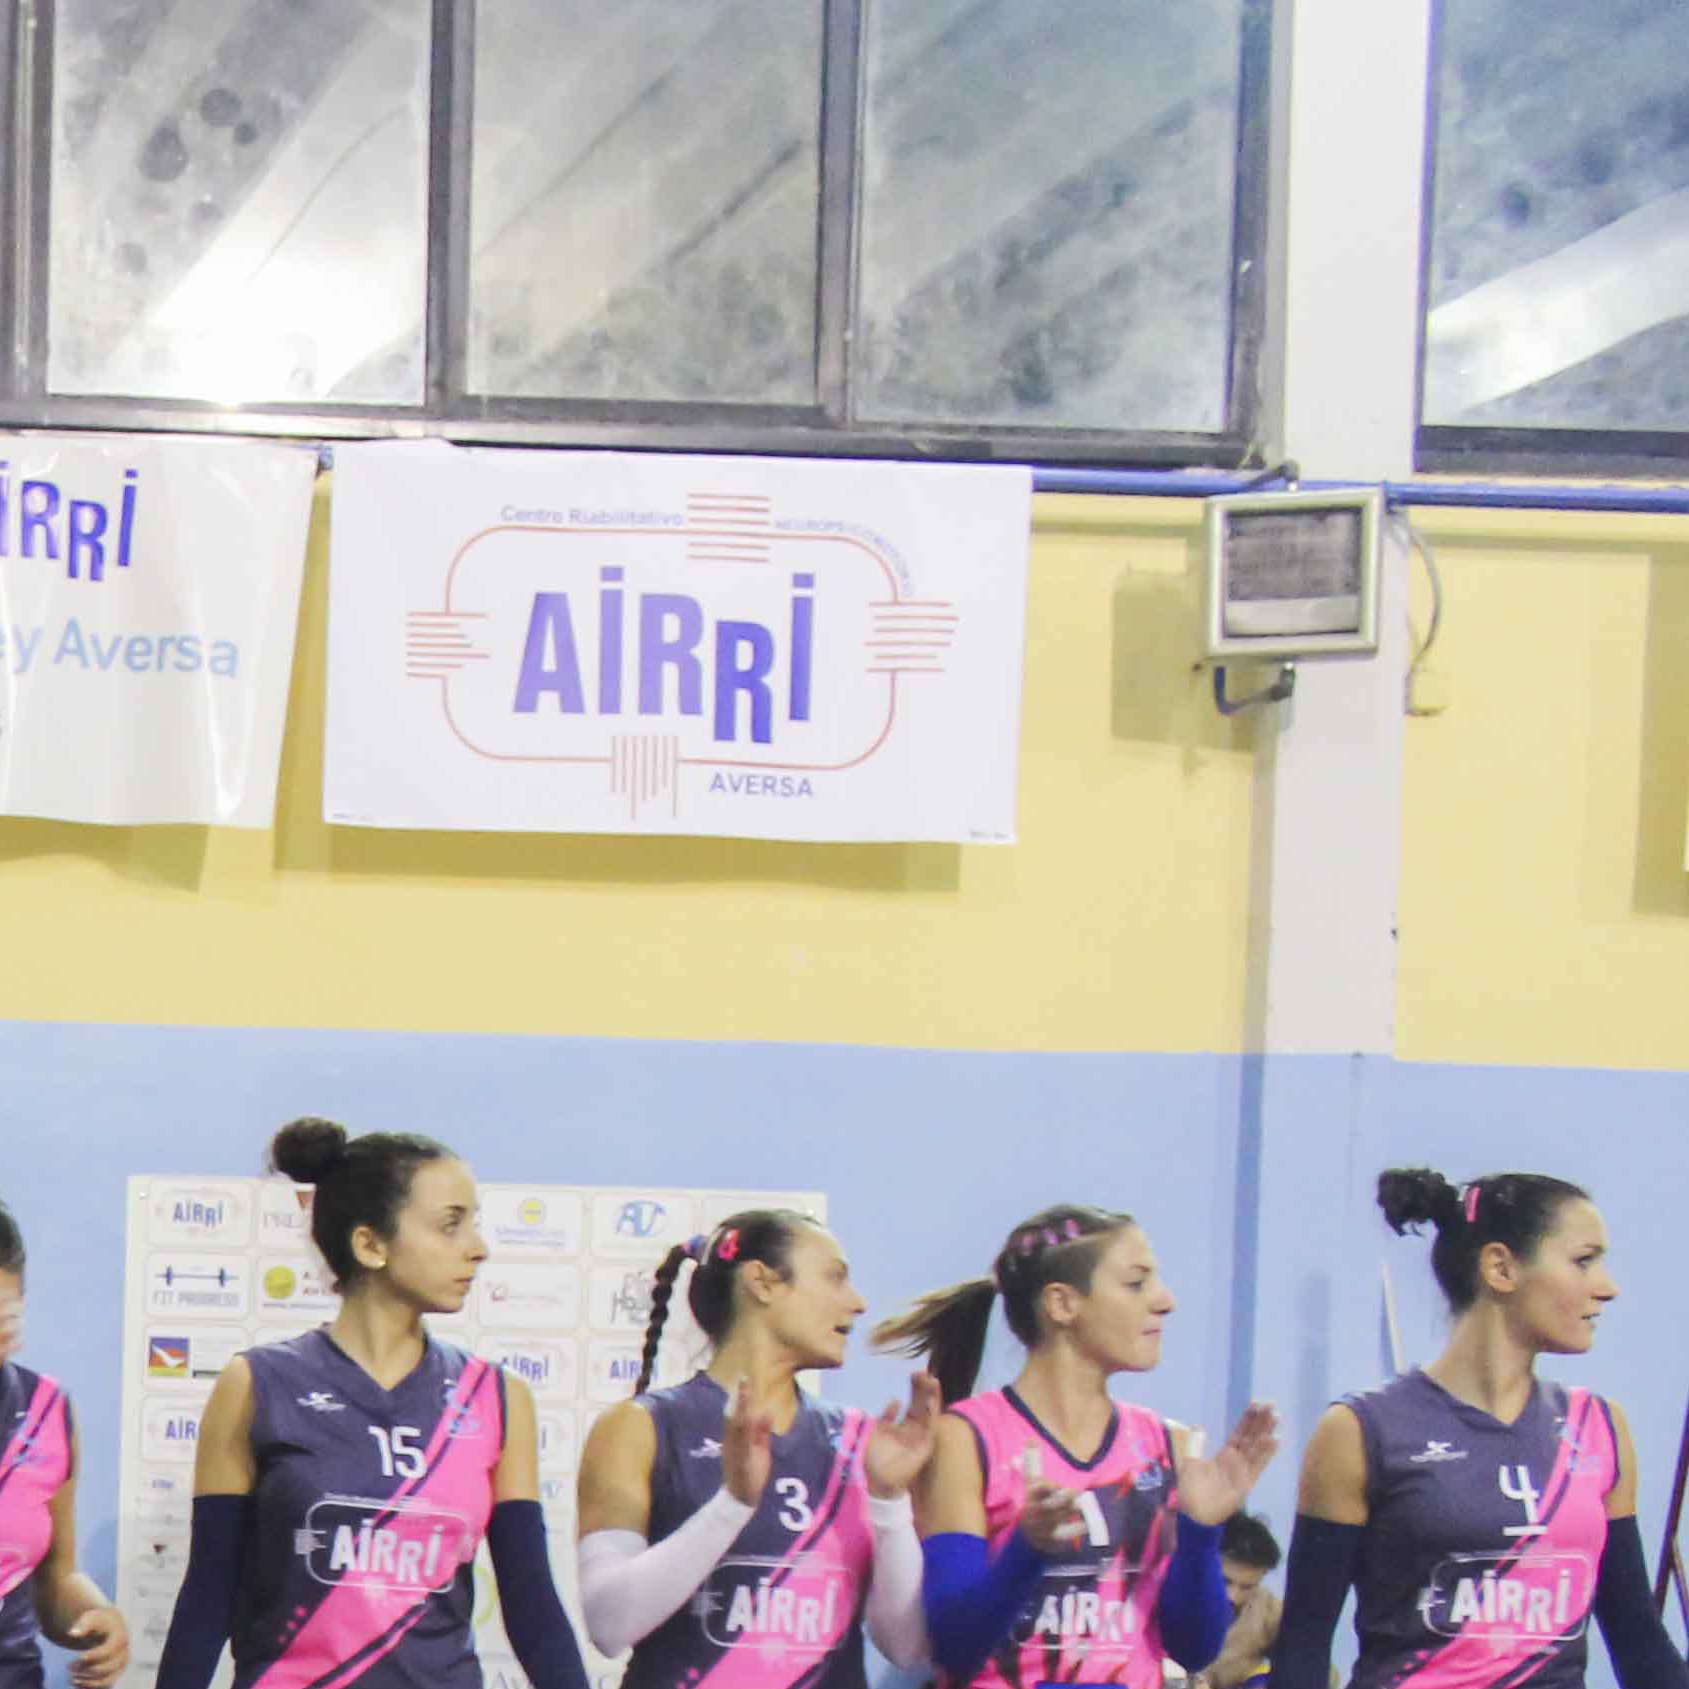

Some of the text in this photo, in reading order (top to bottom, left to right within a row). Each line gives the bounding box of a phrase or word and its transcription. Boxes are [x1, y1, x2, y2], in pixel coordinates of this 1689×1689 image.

[52, 615, 240, 678] Aversa
[710, 771, 814, 798] AVERSA
[368, 1425, 427, 1479] 15
[774, 1476, 812, 1532] 3
[1498, 1464, 1540, 1527] 4
